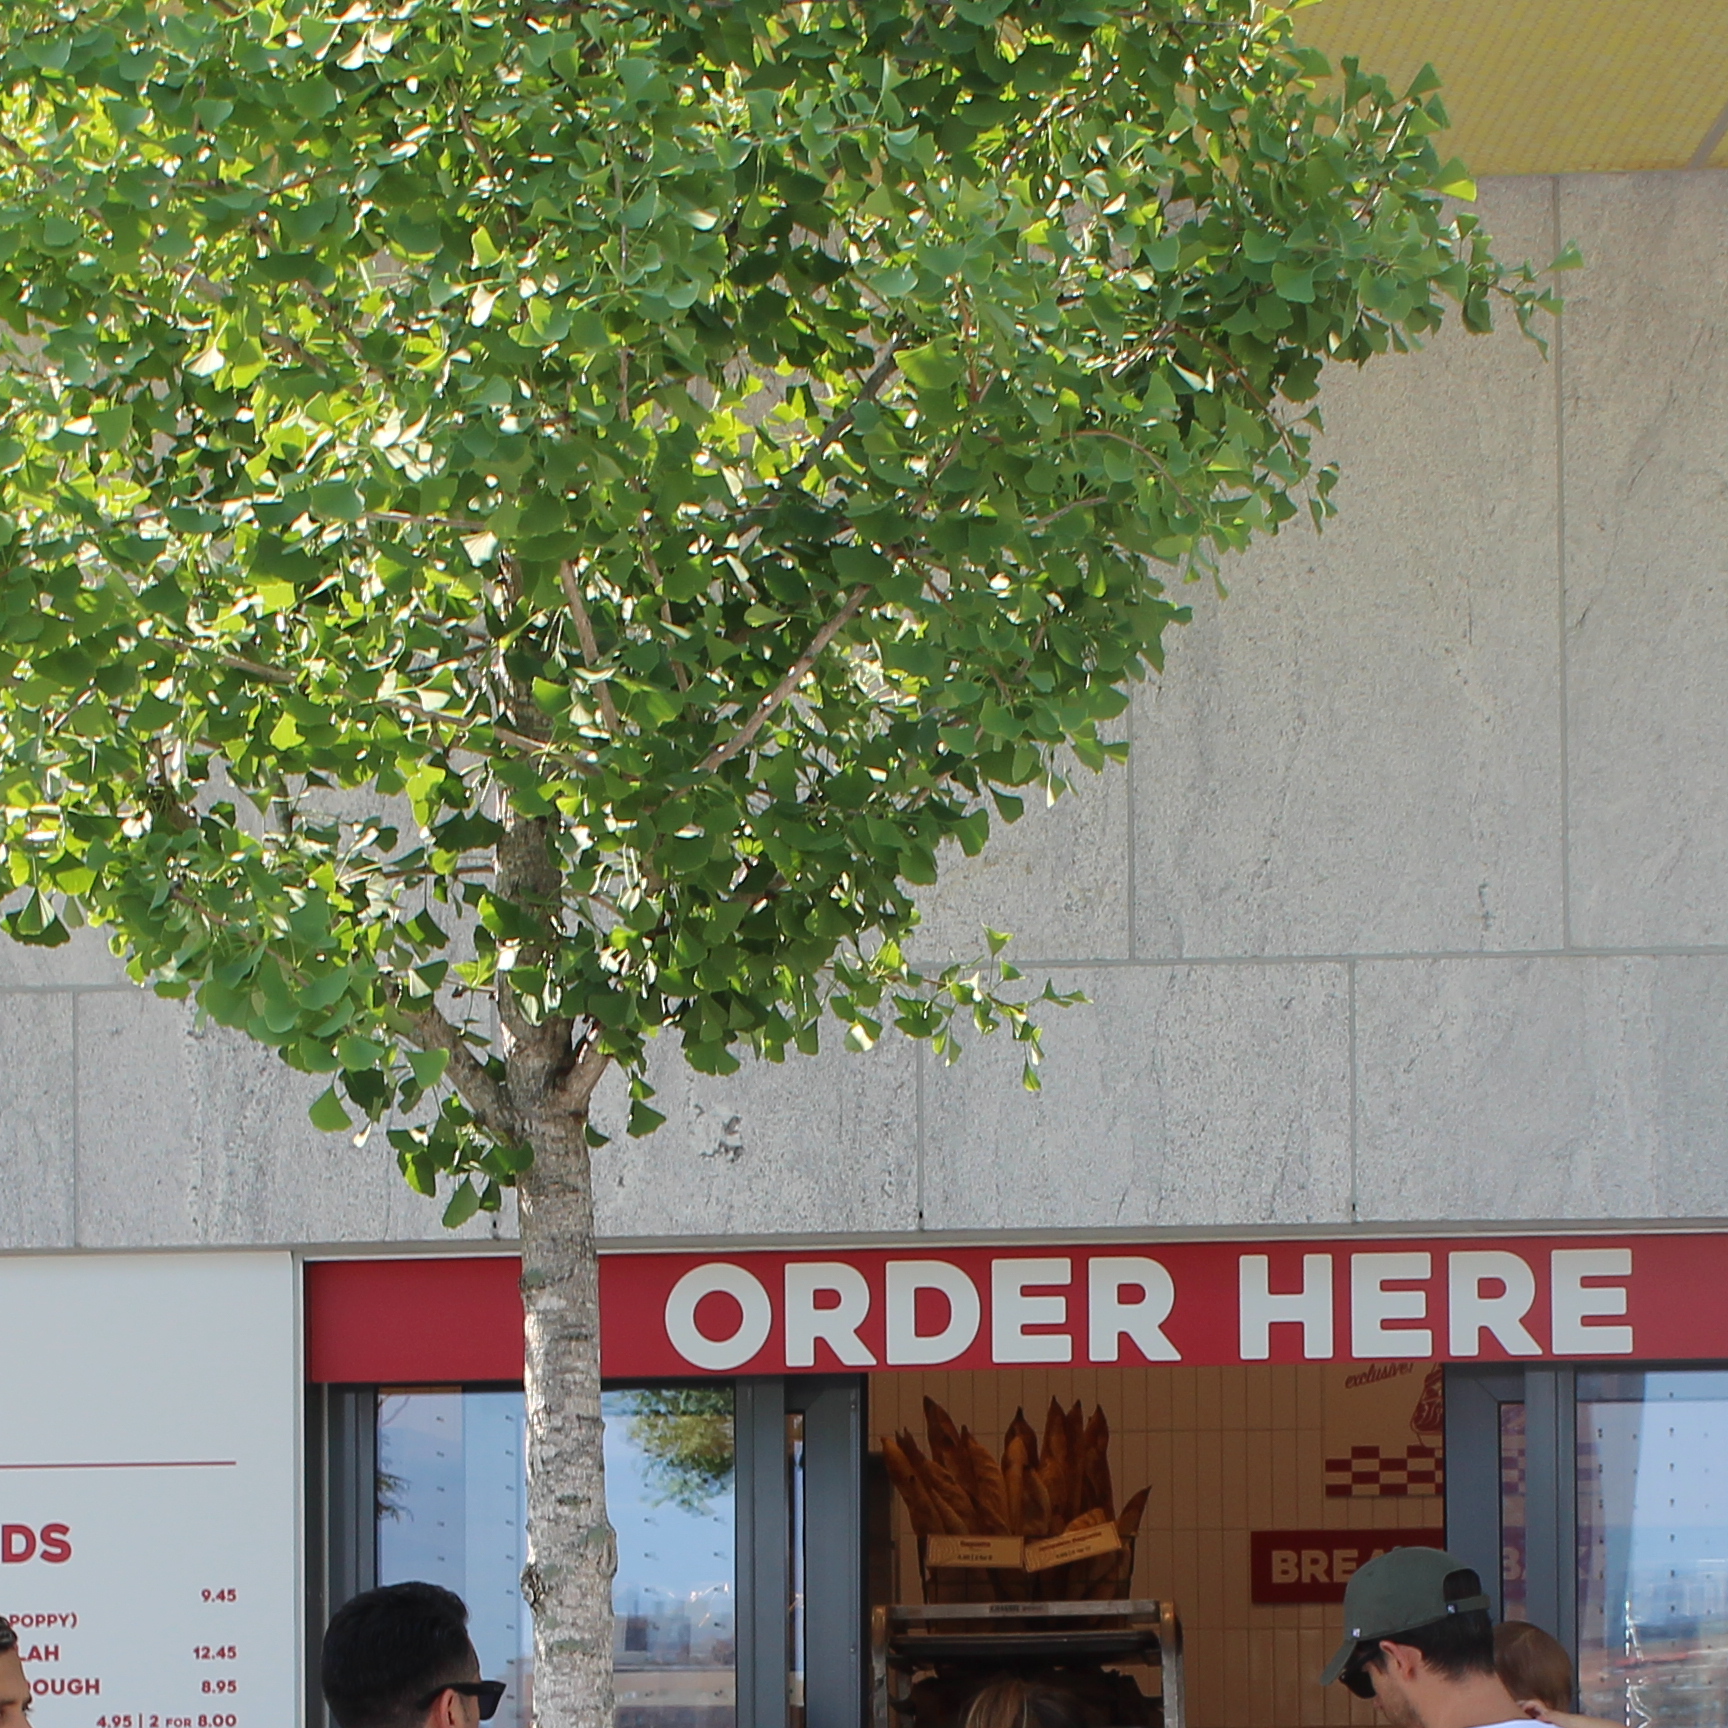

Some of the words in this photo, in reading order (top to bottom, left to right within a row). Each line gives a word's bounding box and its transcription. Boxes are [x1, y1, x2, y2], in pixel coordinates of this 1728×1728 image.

[663, 1256, 1182, 1371] ORDER
[1238, 1248, 1634, 1361] HERE
[201, 1588, 237, 1603] 9.45
[193, 1645, 237, 1660] 12.45
[201, 1679, 237, 1694] 8.95
[96, 1714, 133, 1728] 4.95
[149, 1714, 159, 1728] 2
[165, 1717, 192, 1728] FOR
[197, 1713, 237, 1728] 8.00
